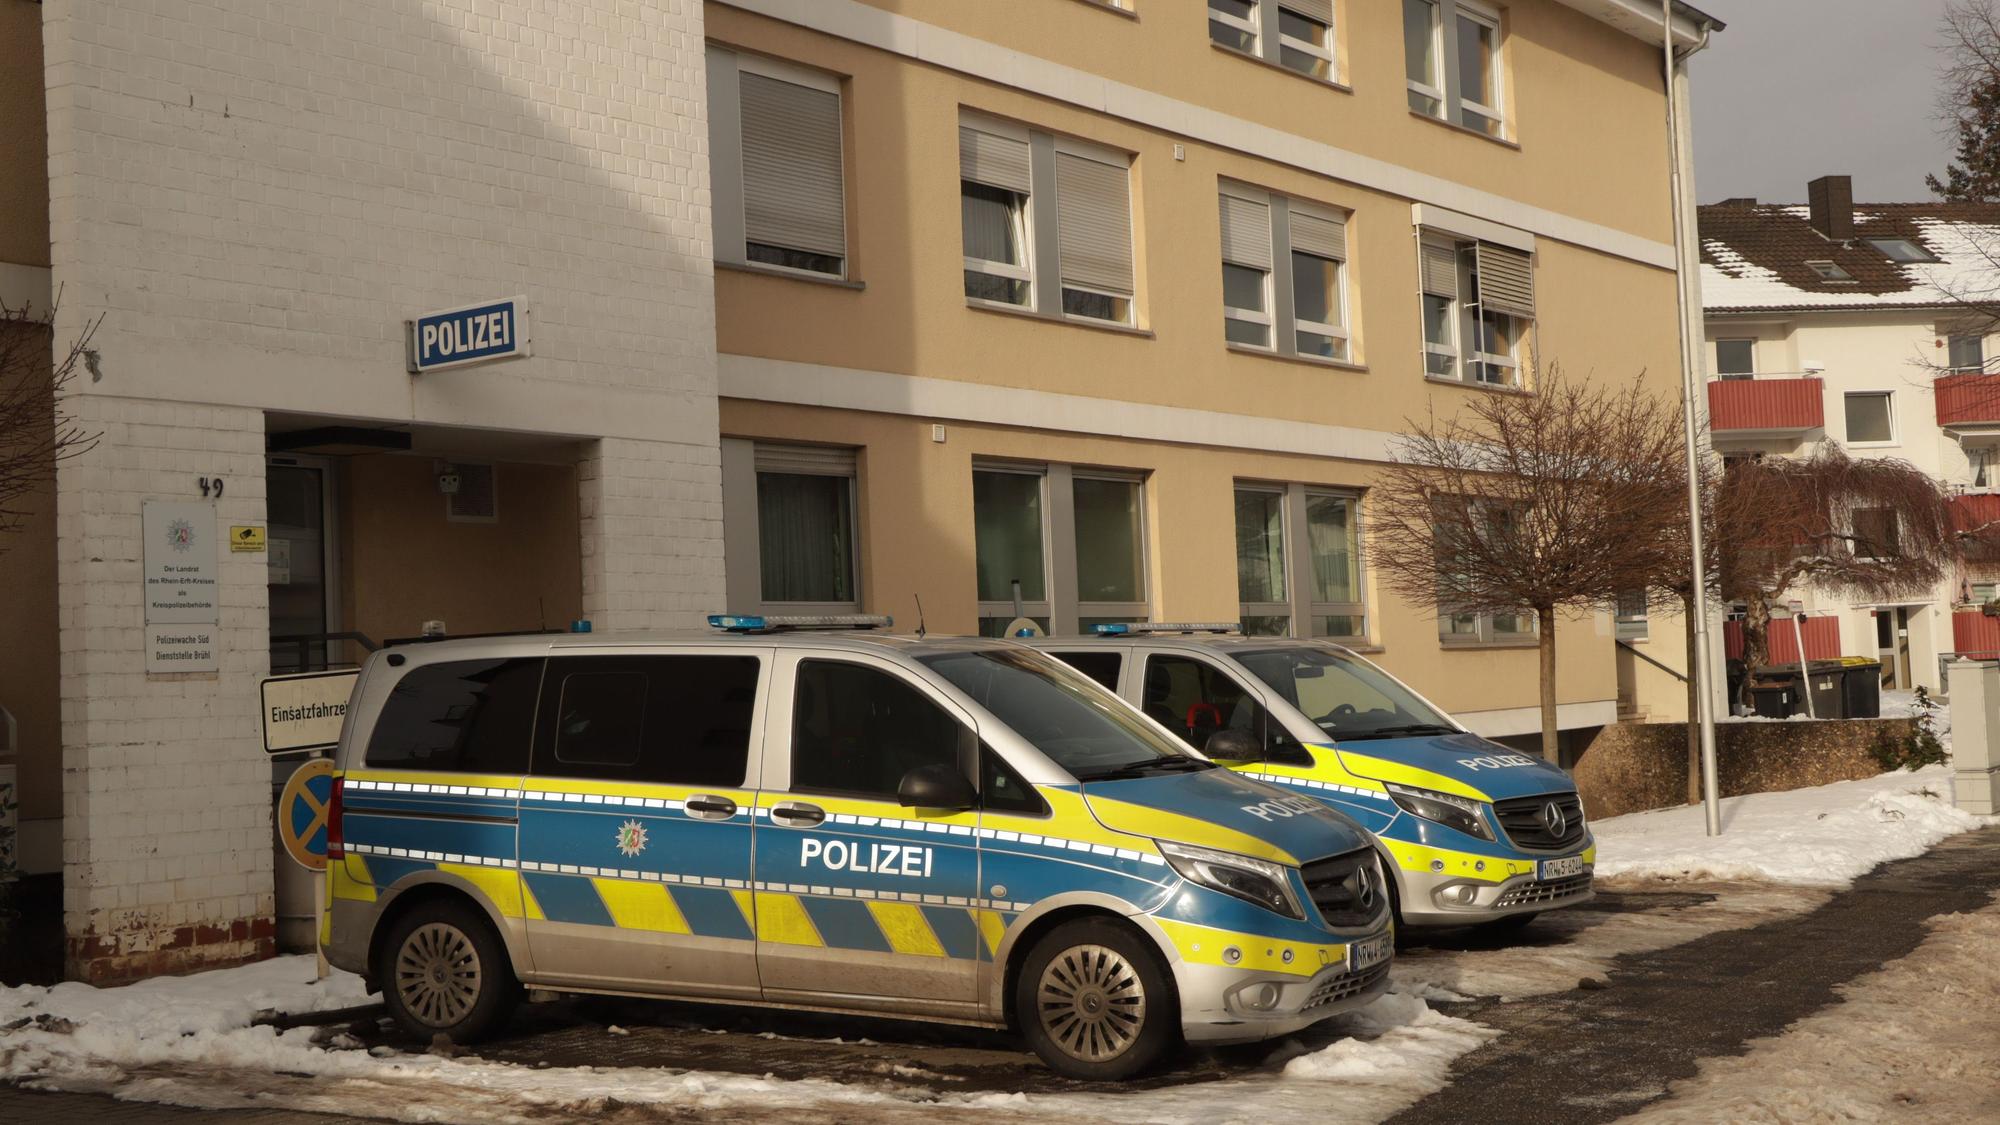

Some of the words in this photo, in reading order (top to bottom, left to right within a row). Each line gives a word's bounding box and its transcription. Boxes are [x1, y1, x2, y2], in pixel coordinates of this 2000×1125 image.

[422, 309, 511, 359] POLIZEI
[199, 476, 225, 498] 49
[152, 601, 211, 609] Kreispolizeibehörde
[156, 634, 196, 645] Polizeiwache
[198, 634, 209, 644] Süd
[156, 651, 192, 660] Dienststelle
[194, 650, 211, 660] Brühl
[1456, 754, 1538, 771] POLIZEI
[801, 838, 933, 877] POLIZEI
